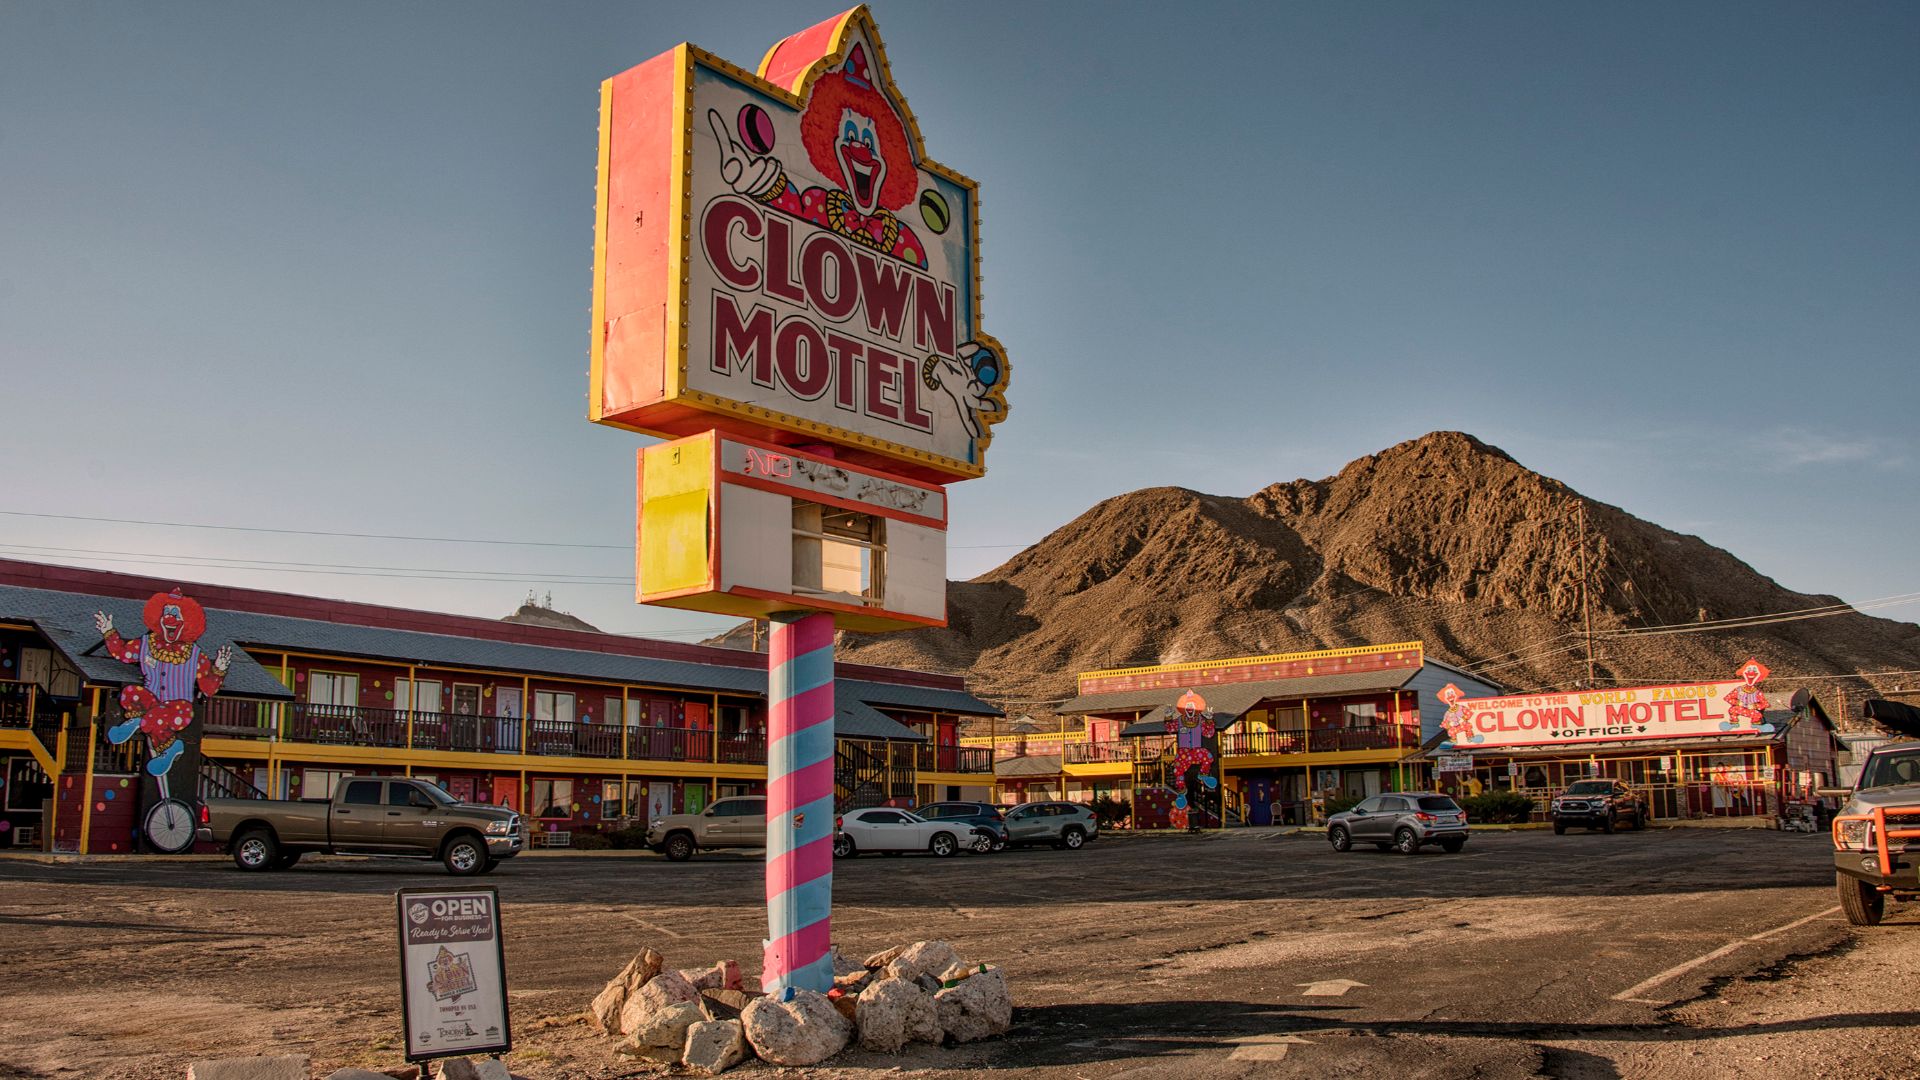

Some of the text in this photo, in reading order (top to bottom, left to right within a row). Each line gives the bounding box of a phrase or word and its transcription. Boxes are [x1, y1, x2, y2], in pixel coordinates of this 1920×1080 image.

[700, 194, 957, 362] CLOWN
[710, 288, 933, 435] MOTEL
[745, 449, 792, 478] NO
[1468, 684, 1717, 710] WELCOME TO THE WORLD FAMOUS
[1475, 698, 1724, 733] CLOWN MOTEL
[1562, 726, 1633, 737] OFFICE
[431, 899, 487, 916] OPEN
[411, 923, 490, 939] Ready to Serve You!
